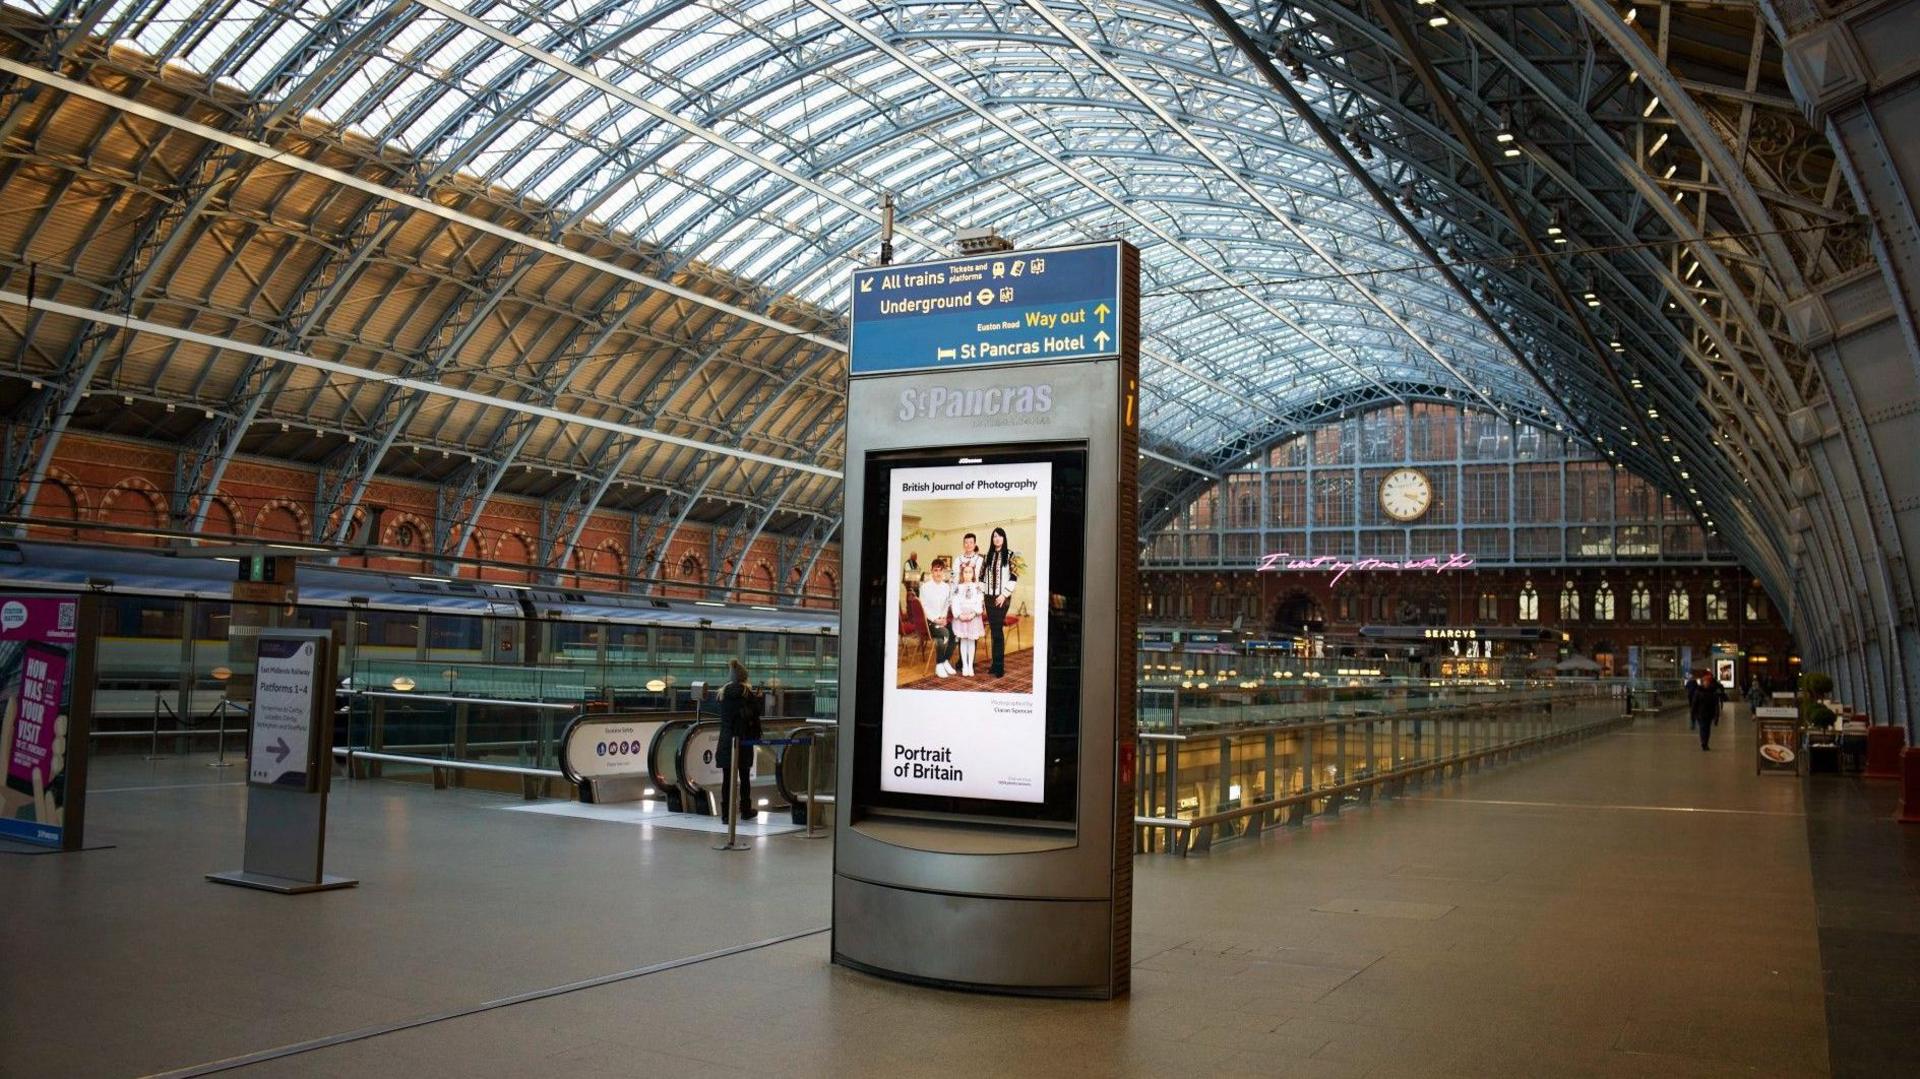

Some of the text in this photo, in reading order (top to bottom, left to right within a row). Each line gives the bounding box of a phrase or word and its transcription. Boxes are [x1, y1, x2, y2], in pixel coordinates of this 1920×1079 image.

[948, 272, 983, 284] platforms
[949, 262, 988, 274] Tickets and
[881, 270, 945, 291] All trains
[880, 292, 972, 315] Underground
[977, 308, 1086, 332] Euston Road Way out
[960, 334, 1085, 360] St Pancras Hotel
[928, 384, 1052, 419] Pancras
[902, 478, 1038, 493] British Journal of Photography
[1424, 629, 1477, 639] SEARCYS
[26, 657, 48, 681] HOW
[24, 678, 44, 701] WAS
[260, 682, 308, 695] Platforms 1-4
[21, 698, 45, 724] YOUR
[18, 719, 42, 744] VISIT
[895, 744, 952, 763] Portrait
[894, 762, 963, 781] of Britain
